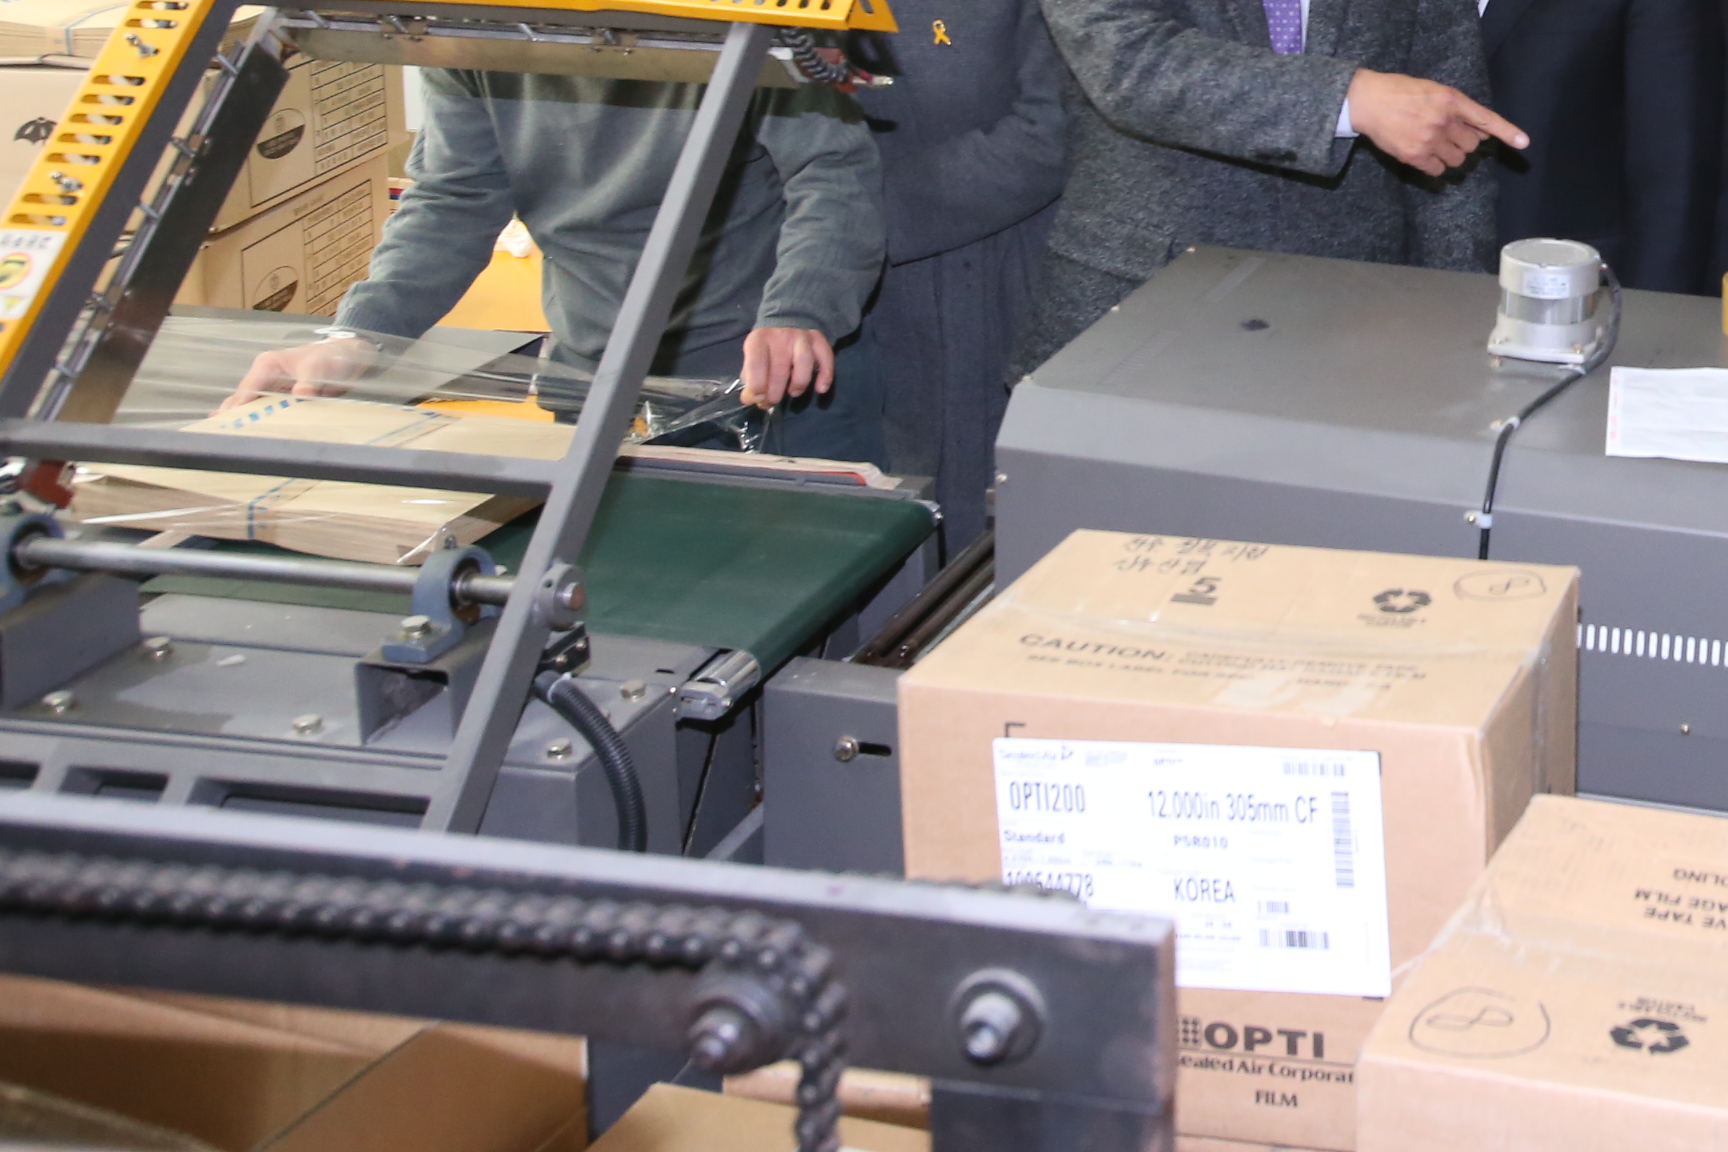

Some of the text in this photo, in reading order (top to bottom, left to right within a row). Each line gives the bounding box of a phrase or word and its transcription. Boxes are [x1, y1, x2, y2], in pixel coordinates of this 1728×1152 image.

[1188, 576, 1222, 594] 5
[1009, 781, 1086, 813] OPTI200
[1148, 790, 1318, 824] 12.000in 305mm CF
[1173, 877, 1236, 904] KOREA
[1634, 888, 1682, 906] FILM
[1642, 906, 1693, 925] TAPE
[1204, 1022, 1324, 1058] OPTI
[1178, 1056, 1354, 1084] ealed Air Corporat
[1255, 1090, 1299, 1107] FILM
